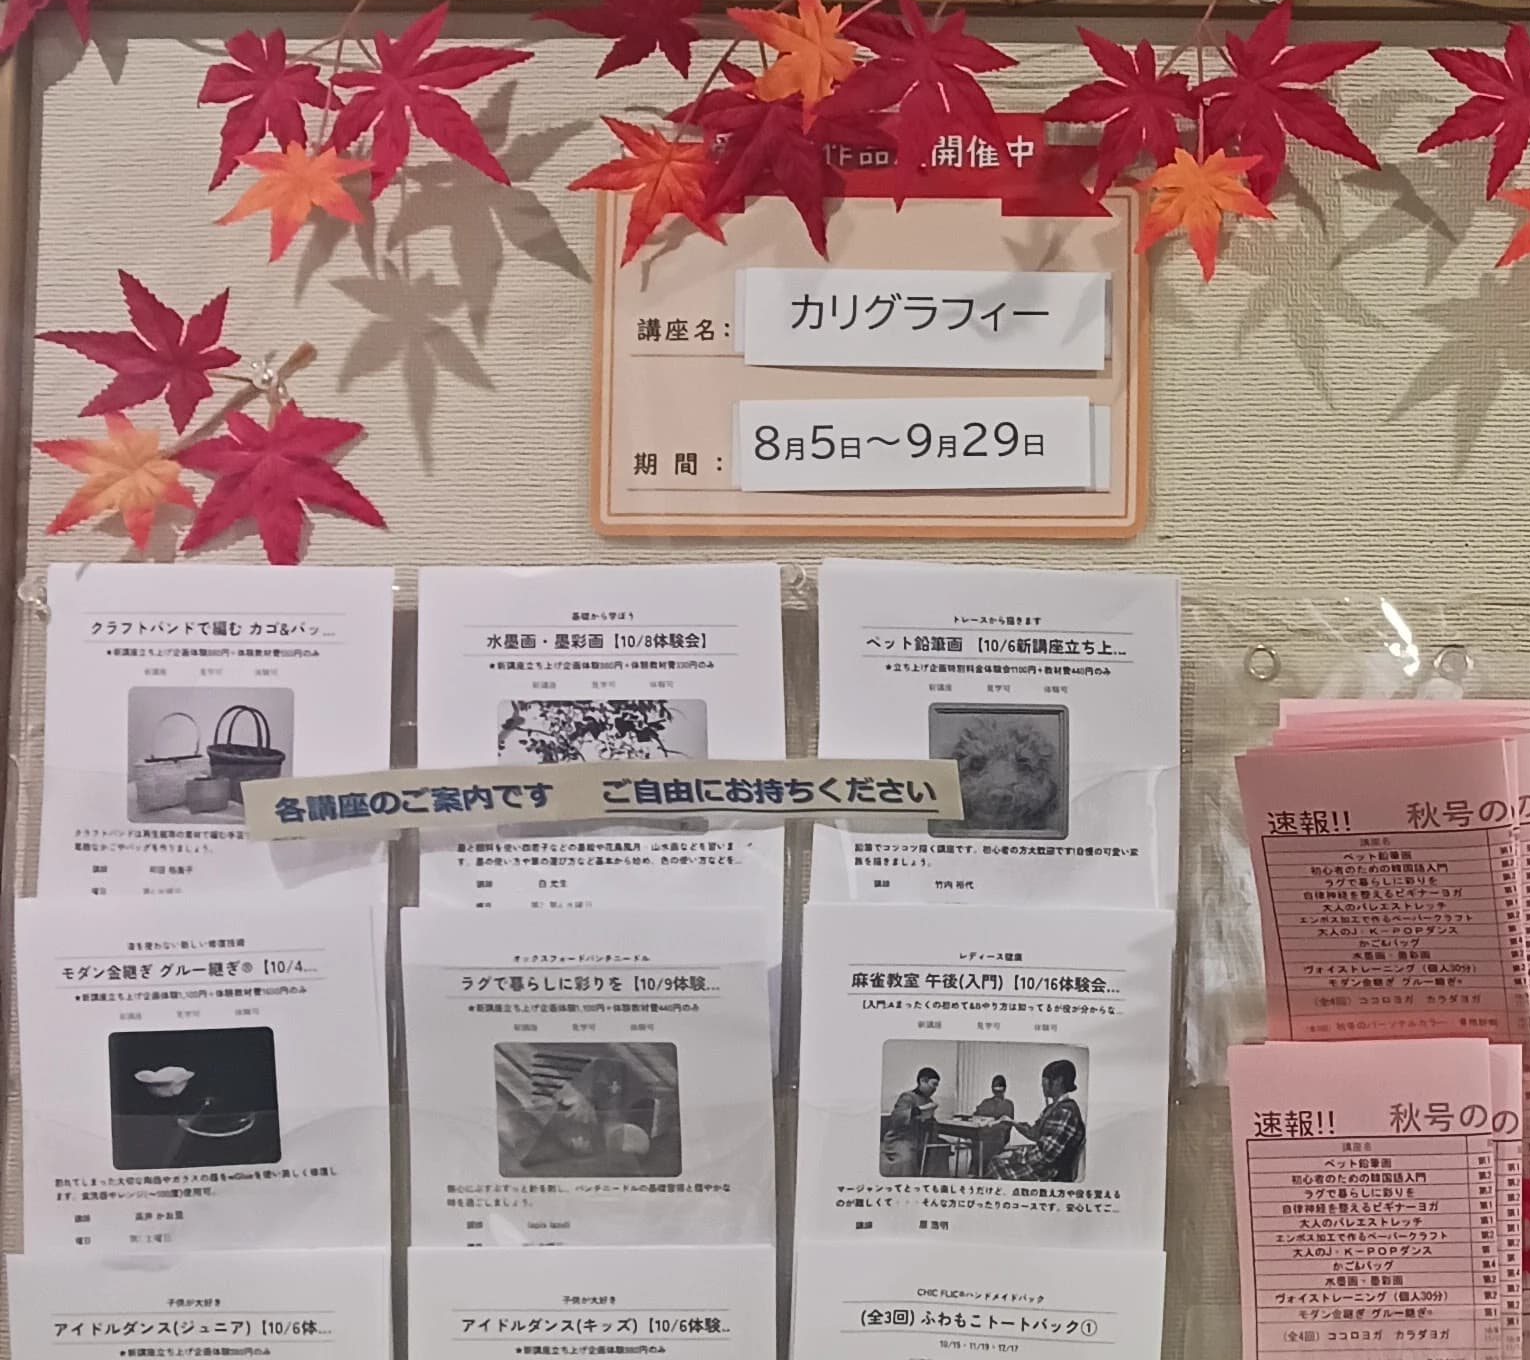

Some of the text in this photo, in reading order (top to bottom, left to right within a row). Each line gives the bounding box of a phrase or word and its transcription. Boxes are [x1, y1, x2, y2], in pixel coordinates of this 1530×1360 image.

[791, 292, 1050, 333] カリグラフィー
[274, 776, 939, 823] 各講座のご案内です ご自由にお持ちください
[1266, 810, 1352, 835] 速報!!
[850, 971, 921, 989] 麻雀教室
[1253, 1109, 1335, 1138] 速報!!
